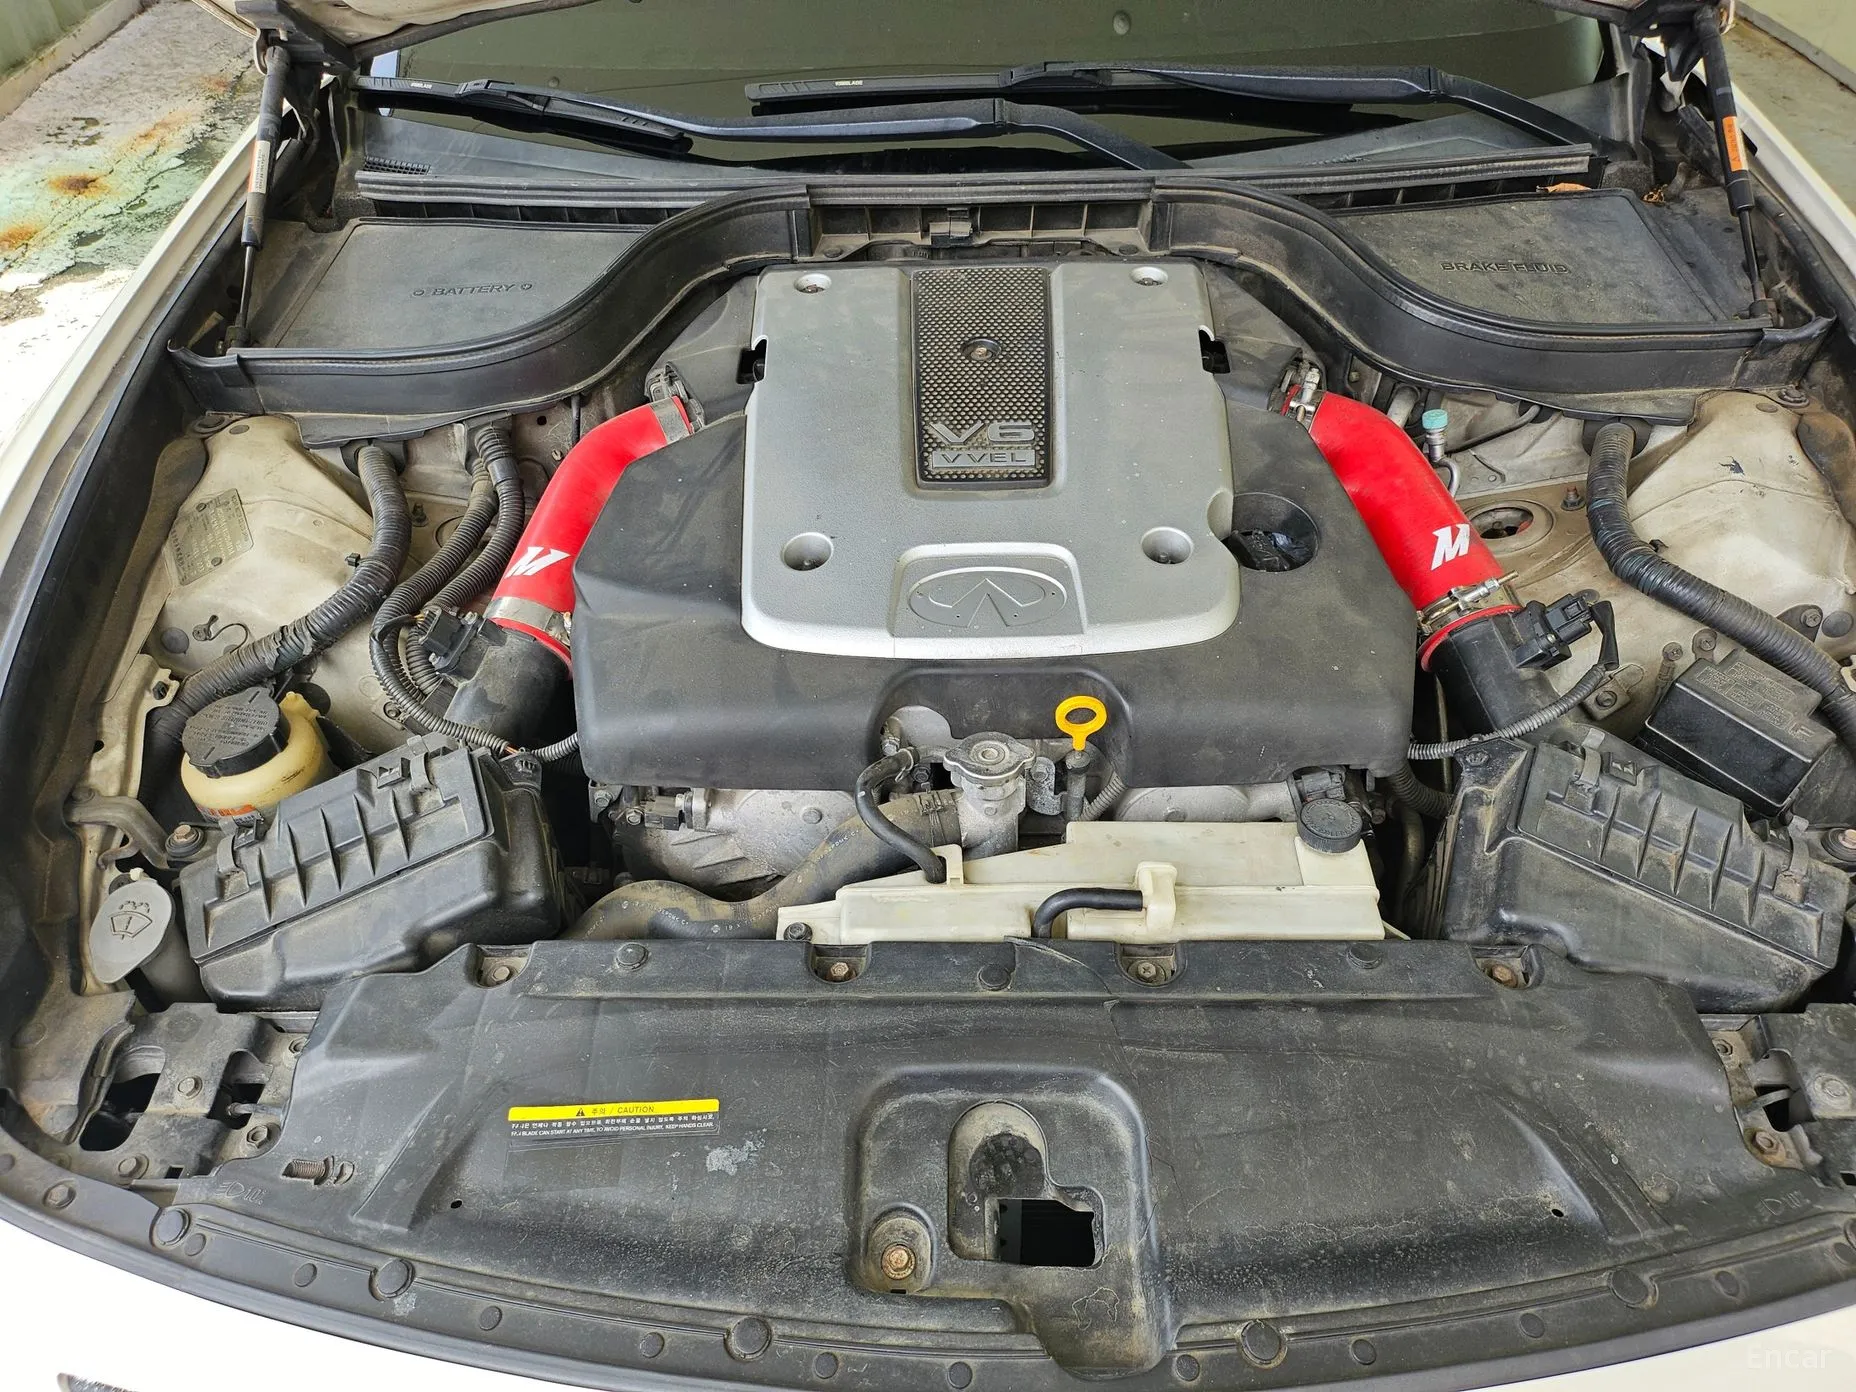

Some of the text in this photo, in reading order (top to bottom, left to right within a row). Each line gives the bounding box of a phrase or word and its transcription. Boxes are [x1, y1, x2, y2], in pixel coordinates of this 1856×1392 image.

[1440, 262, 1572, 275] BRAKE FLUID
[431, 284, 516, 296] BATTERY
[929, 419, 1035, 444] V6
[941, 452, 1027, 464] VVEL
[591, 1107, 606, 1116] 주의
[617, 1106, 655, 1114] CAUTION
[619, 1124, 647, 1132] PERSONAL
